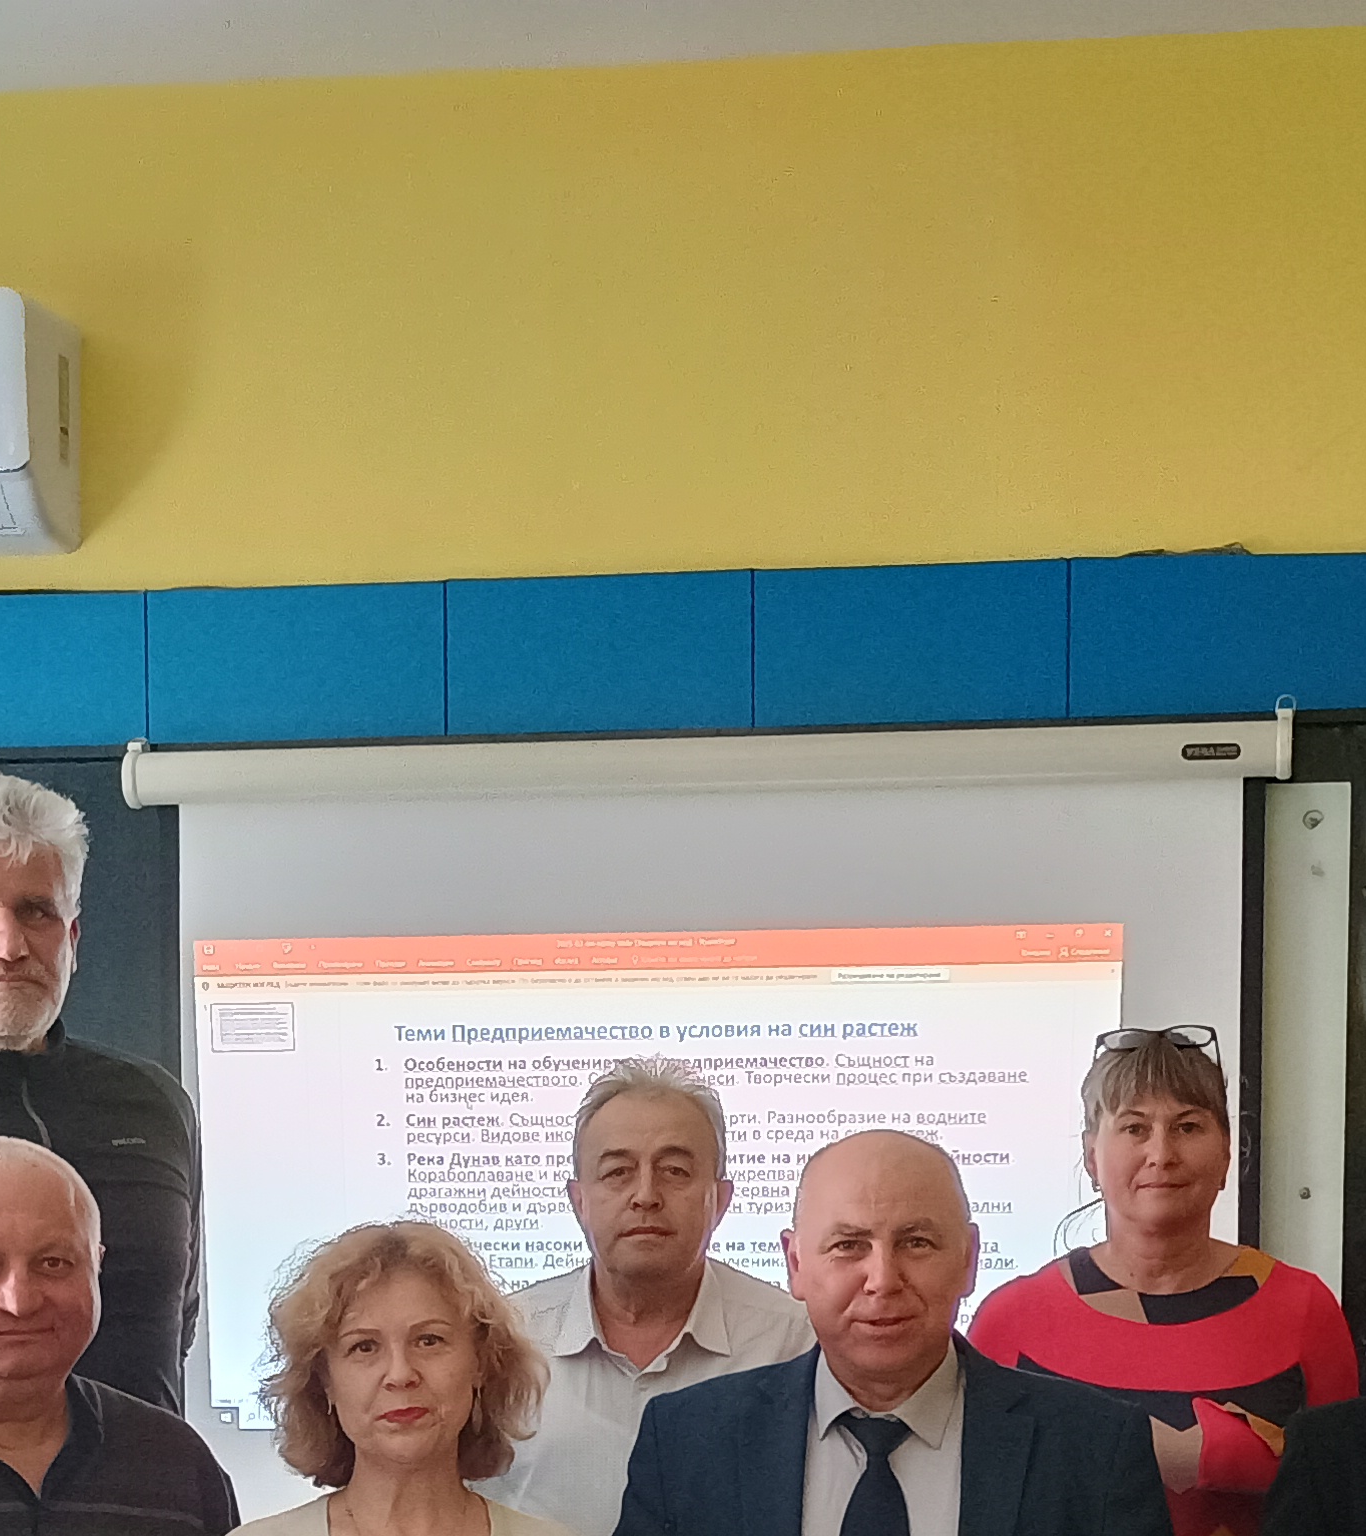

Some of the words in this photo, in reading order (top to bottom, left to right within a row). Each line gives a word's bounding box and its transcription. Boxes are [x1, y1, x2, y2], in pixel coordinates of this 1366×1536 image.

[395, 1026, 445, 1041] Теми
[452, 1025, 652, 1043] Предприемачество
[659, 1026, 670, 1038] в
[676, 1024, 761, 1042] условия
[768, 1024, 792, 1037] на
[798, 1023, 836, 1037] син
[842, 1022, 918, 1040] растеж
[404, 1057, 502, 1072] Особености
[508, 1059, 526, 1070] на
[835, 1054, 910, 1069] Същност
[915, 1056, 933, 1067] на
[405, 1074, 582, 1090] предприемачеството.
[745, 1071, 830, 1085] Творчески
[836, 1071, 898, 1085] процес
[902, 1071, 933, 1084] при
[938, 1069, 1029, 1084] създаване
[406, 1092, 424, 1103] на
[429, 1089, 485, 1103] бизнес
[490, 1091, 534, 1105] идея.
[406, 1114, 436, 1128] Син
[442, 1115, 503, 1131] растеж.
[767, 1109, 886, 1128] Разнообразие
[892, 1112, 911, 1124] на
[916, 1112, 987, 1126] водните
[407, 1130, 475, 1145] ресурси.
[480, 1129, 540, 1143] Видове
[766, 1129, 814, 1144] среда
[407, 1153, 444, 1166] Река
[450, 1153, 500, 1168] Дунав
[505, 1155, 540, 1166] като
[773, 1153, 791, 1164] на
[407, 1168, 535, 1183] Корабоплаване
[407, 1187, 486, 1199] драгажни
[407, 1202, 507, 1214] дърводобив
[525, 1240, 583, 1252] насоки
[726, 1241, 745, 1252] на
